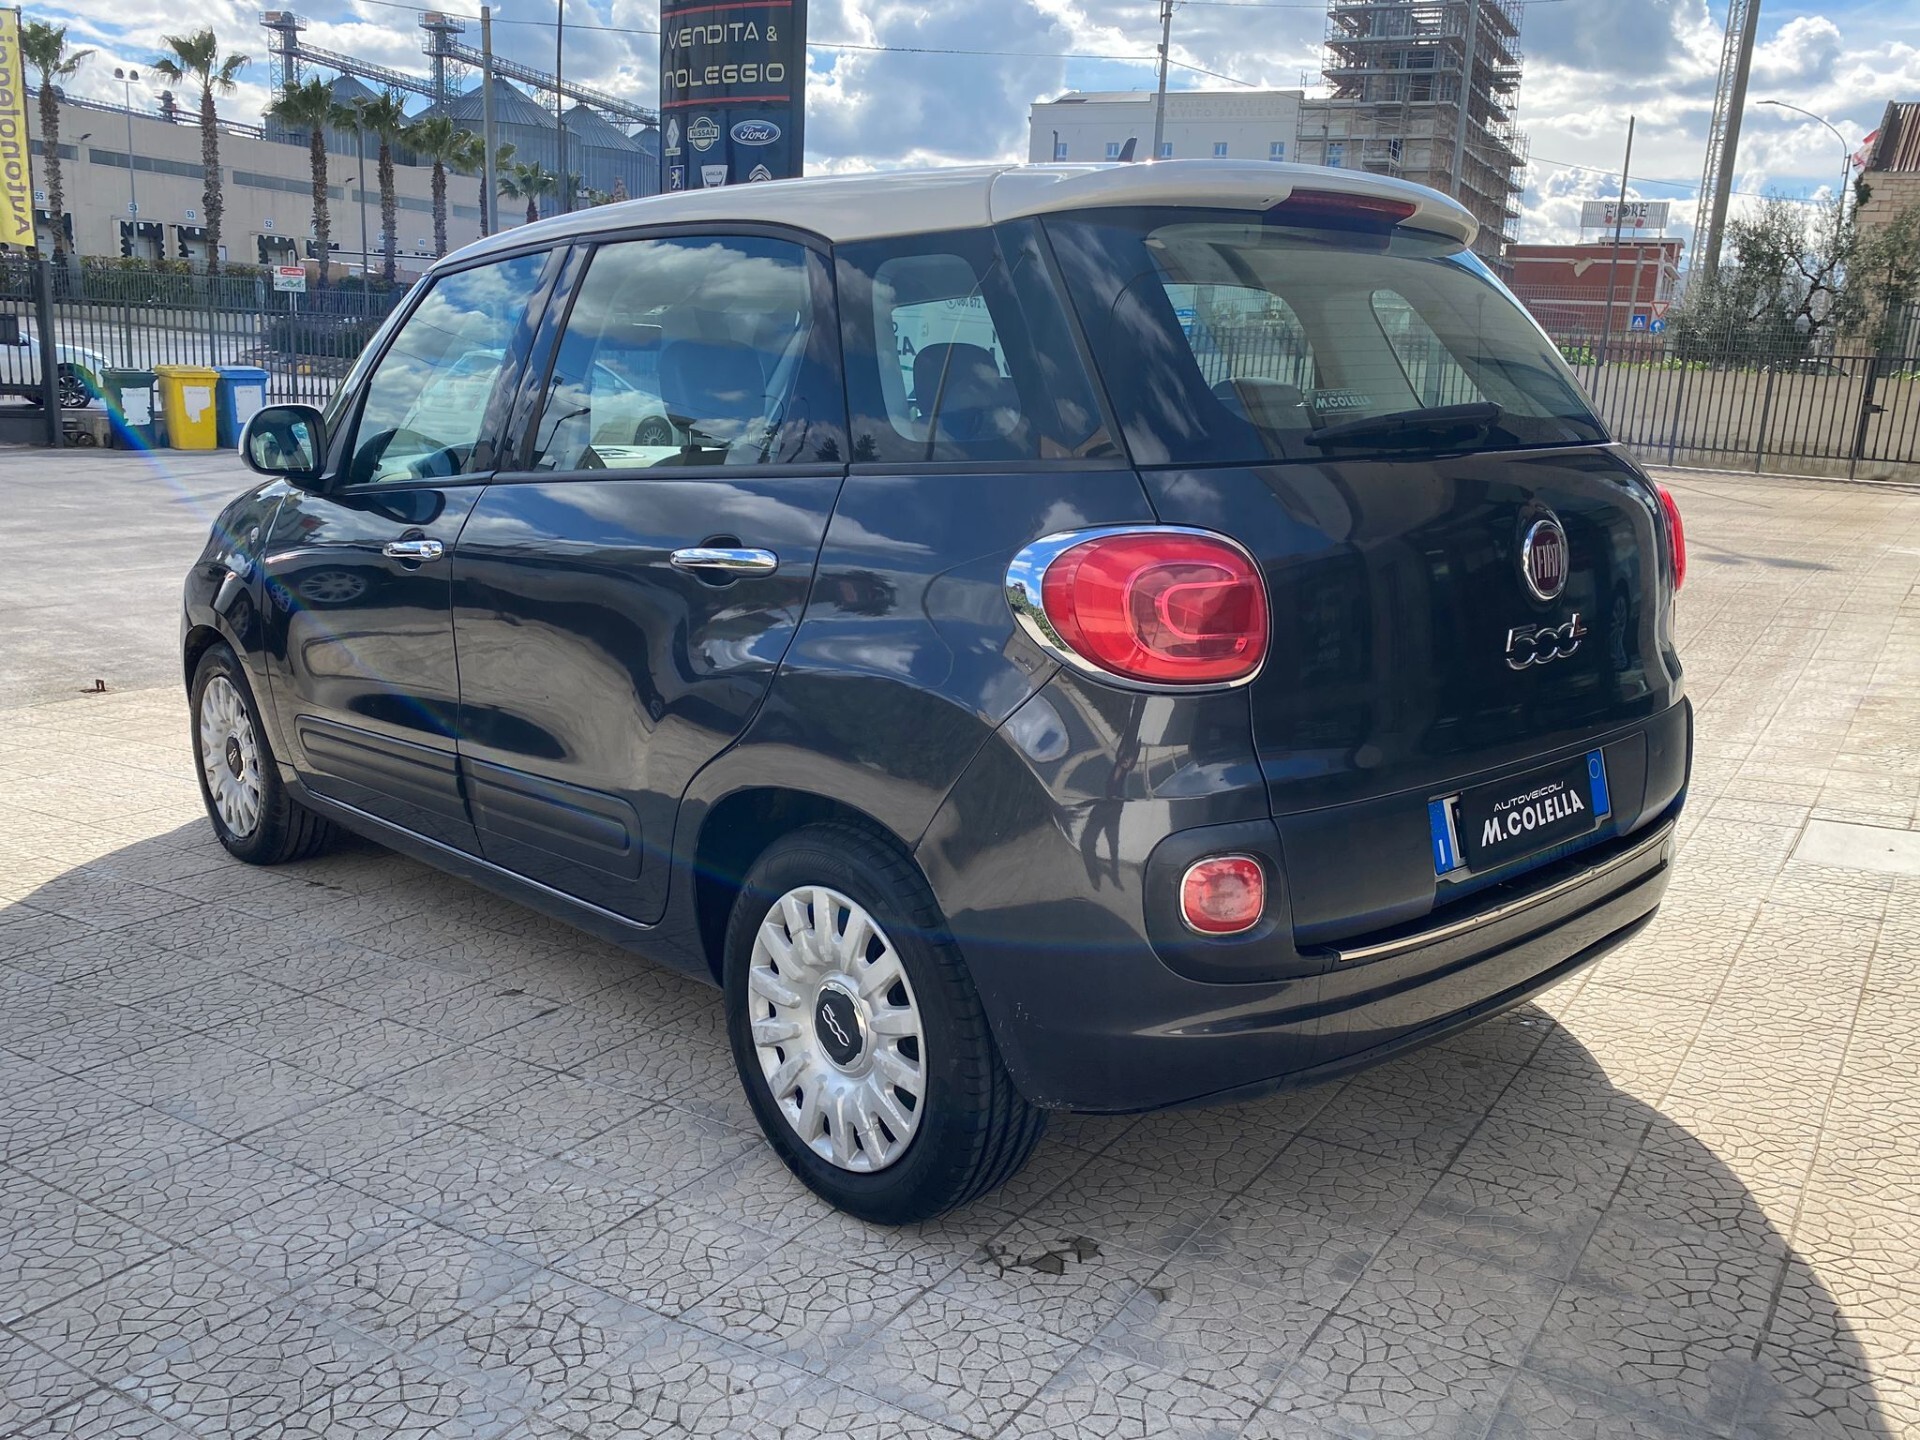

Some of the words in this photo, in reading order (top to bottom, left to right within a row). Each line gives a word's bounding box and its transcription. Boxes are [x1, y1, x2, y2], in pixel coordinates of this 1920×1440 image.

[668, 21, 759, 50] VENDITA
[766, 25, 778, 42] &
[663, 63, 785, 91] NOLEGGIO
[691, 128, 716, 138] NISSAN
[740, 124, 769, 141] Ford
[35, 191, 44, 200] 55
[186, 210, 195, 219] 53
[1604, 203, 1649, 218] FIORE
[265, 220, 273, 228] 52
[1535, 541, 1560, 580] FIAT
[1506, 613, 1588, 670] 500L
[1493, 780, 1564, 813] AUTOVEICOLI
[1481, 789, 1585, 848] M.COLELLA
